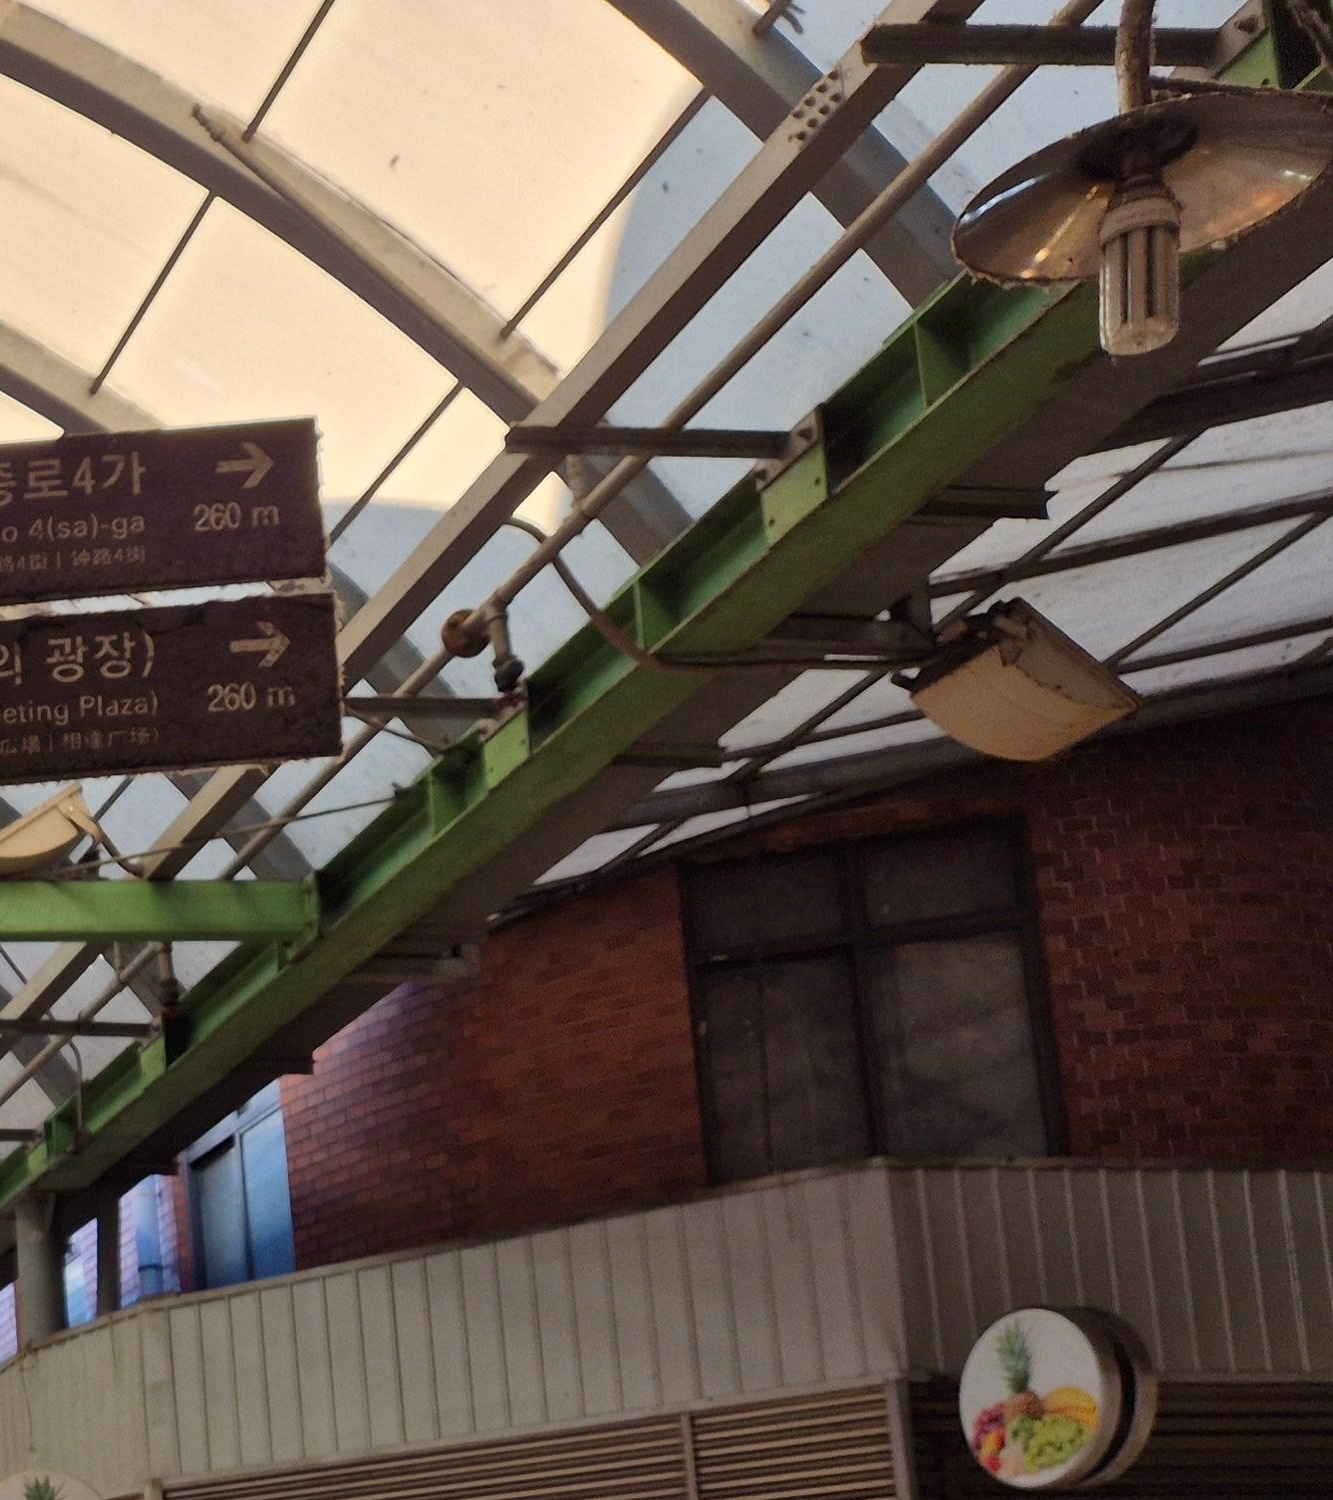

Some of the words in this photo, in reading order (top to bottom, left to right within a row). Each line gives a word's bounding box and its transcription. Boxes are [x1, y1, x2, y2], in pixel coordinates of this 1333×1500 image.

[29, 513, 145, 541] 4(sa)-ga
[195, 504, 240, 531] 260
[251, 504, 279, 526] m
[46, 632, 155, 678] 광장)
[79, 694, 158, 718] Plaza)
[207, 684, 256, 713] 260
[268, 685, 295, 706] m
